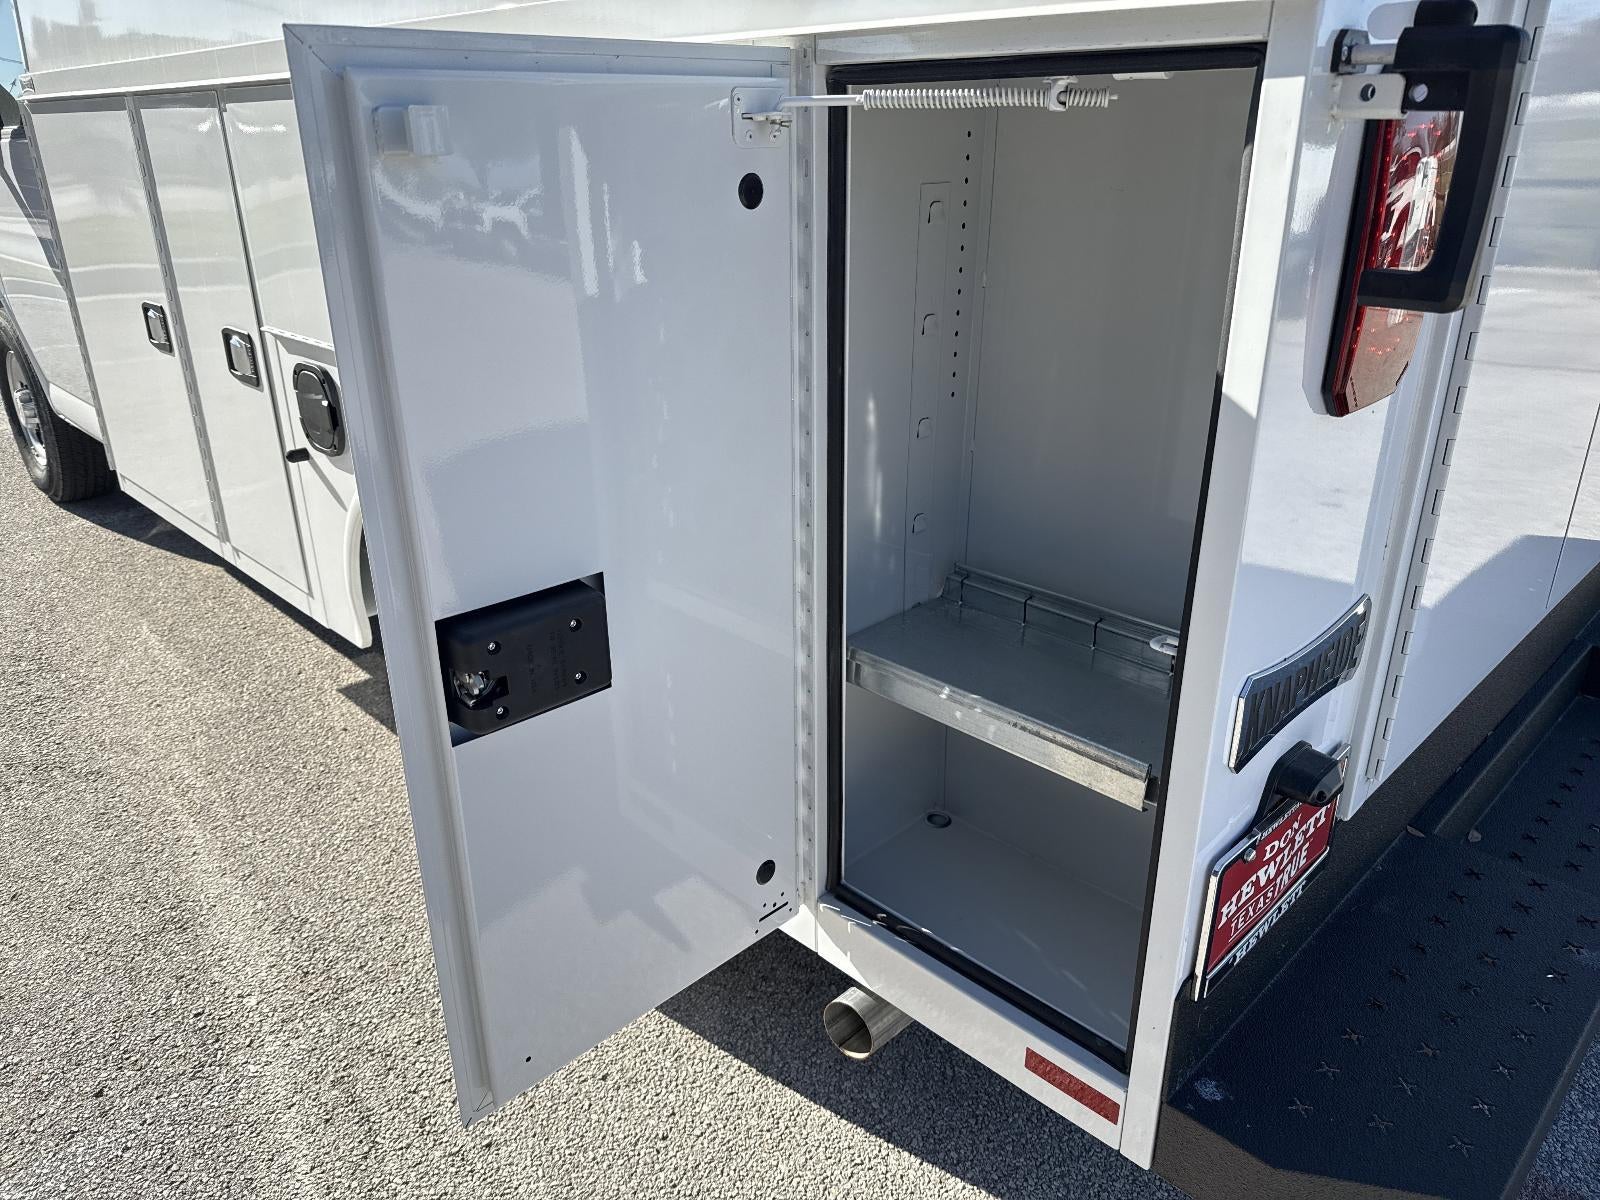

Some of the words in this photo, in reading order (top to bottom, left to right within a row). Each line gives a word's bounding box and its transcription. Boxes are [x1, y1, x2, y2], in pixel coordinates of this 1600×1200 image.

[1243, 611, 1368, 755] KNAPHEIDE
[1217, 804, 1331, 930] HEWLETT
[1263, 813, 1303, 861] DON
[1234, 880, 1307, 966] HEWLETT
